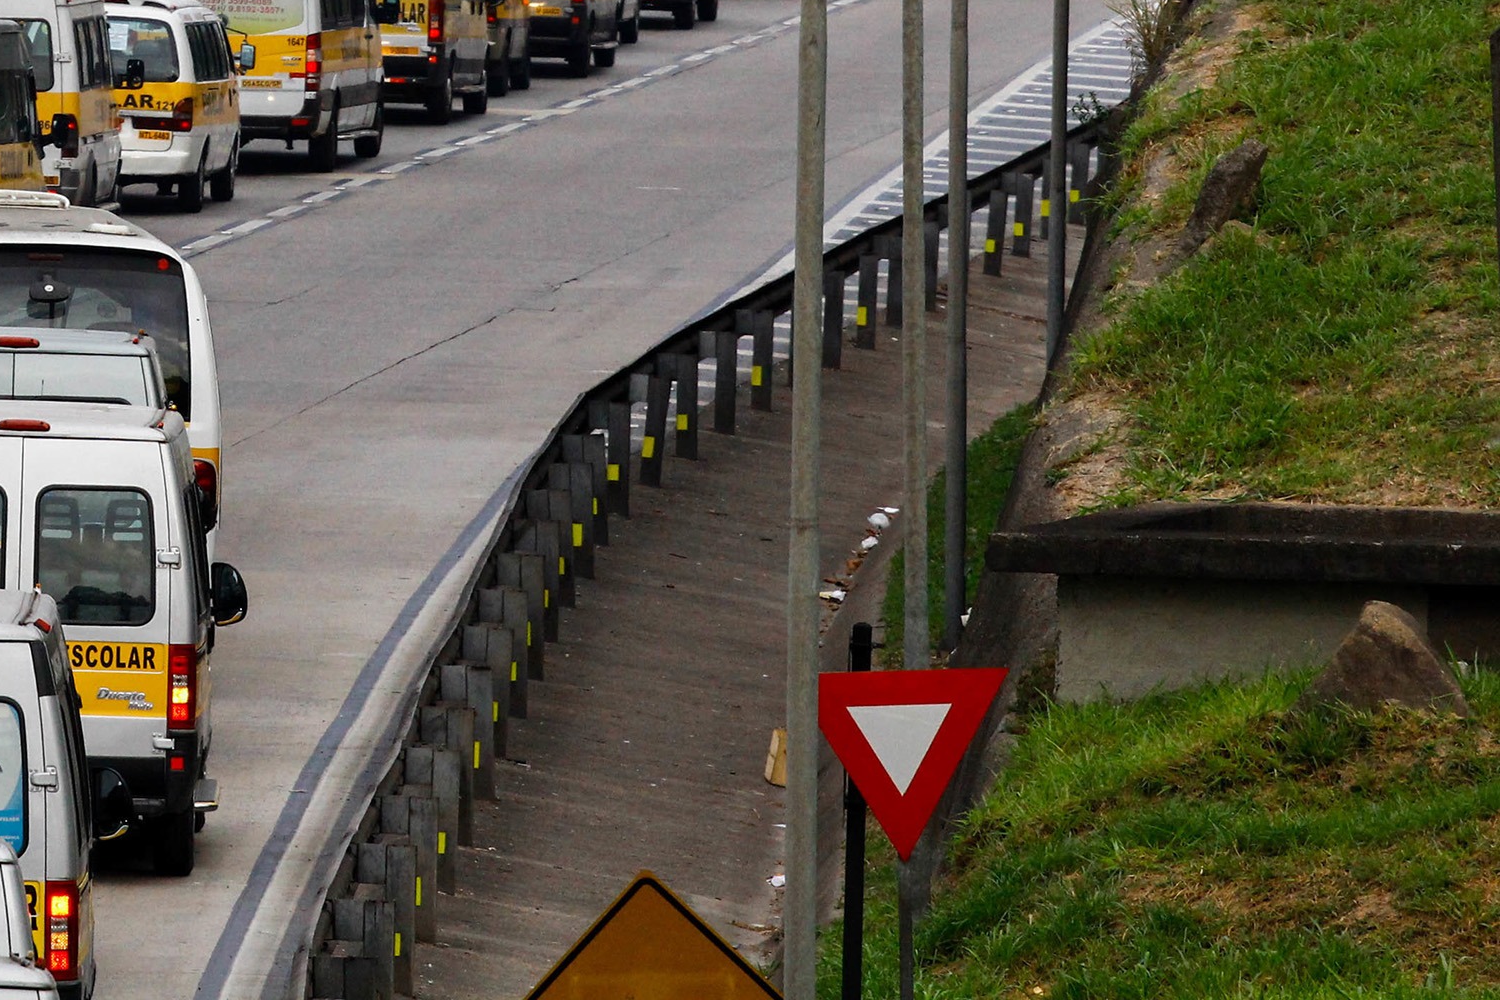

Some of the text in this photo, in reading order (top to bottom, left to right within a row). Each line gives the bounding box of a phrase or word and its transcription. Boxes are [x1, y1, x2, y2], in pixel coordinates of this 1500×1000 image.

[287, 38, 305, 46] 1647
[67, 645, 156, 669] SCOLAR
[97, 686, 146, 700] Ducato
